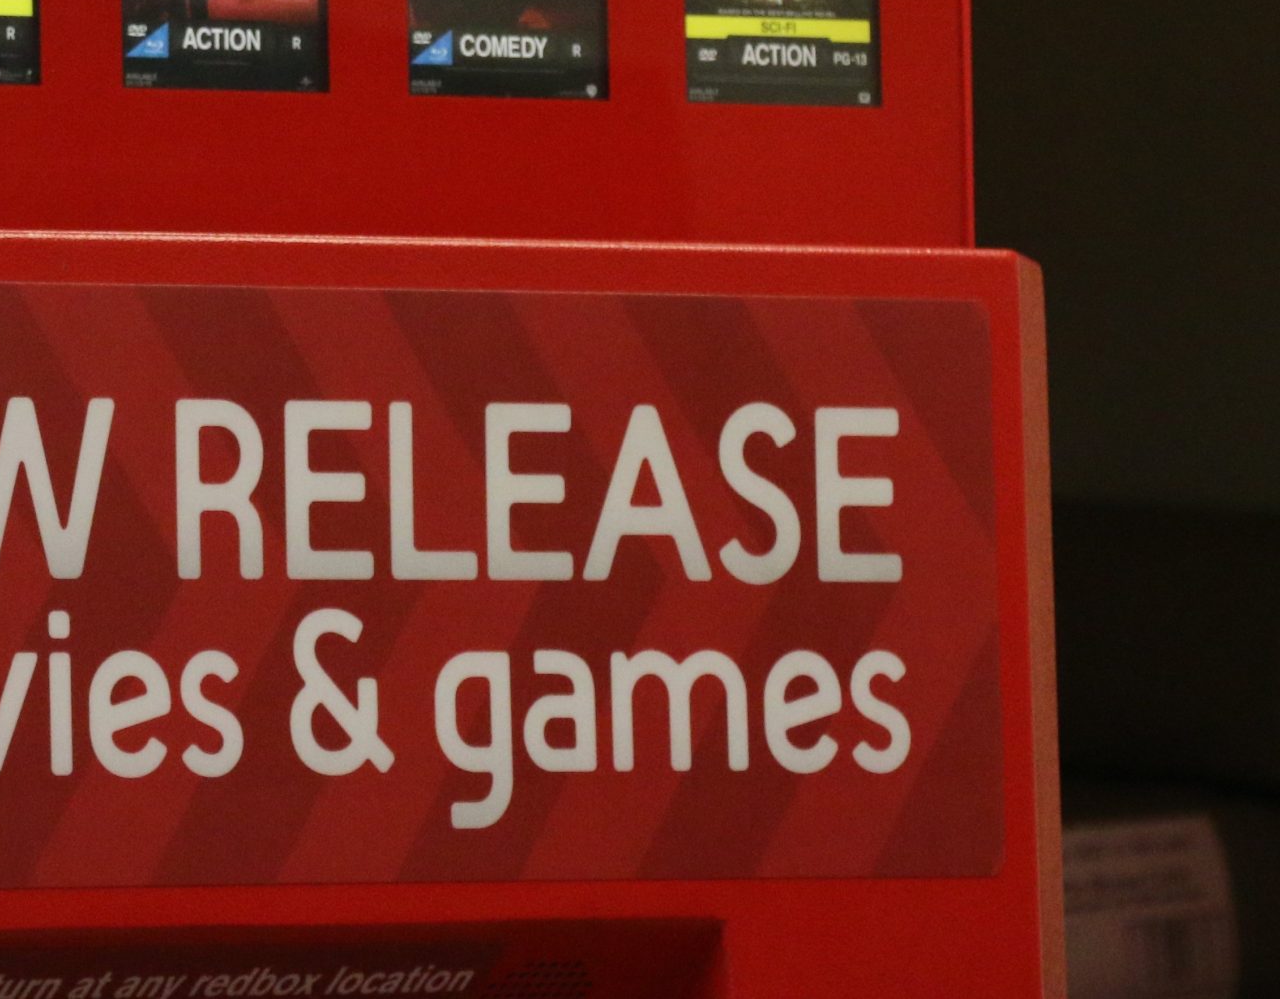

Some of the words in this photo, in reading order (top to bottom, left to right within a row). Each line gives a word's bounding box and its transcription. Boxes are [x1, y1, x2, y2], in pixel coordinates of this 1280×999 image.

[6, 27, 16, 40] R
[182, 26, 261, 51] ACTION
[760, 21, 797, 34] SCI-FI
[291, 36, 302, 50] R
[459, 33, 548, 59] COMEDY
[572, 43, 582, 57] R
[741, 43, 817, 67] ACTION
[832, 52, 868, 66] PG-13
[174, 398, 903, 585] RELEASE
[289, 608, 394, 776] &
[433, 647, 912, 829] games
[69, 971, 113, 999] at
[113, 973, 186, 999] any
[187, 967, 322, 997] redbox
[324, 964, 475, 996] location
